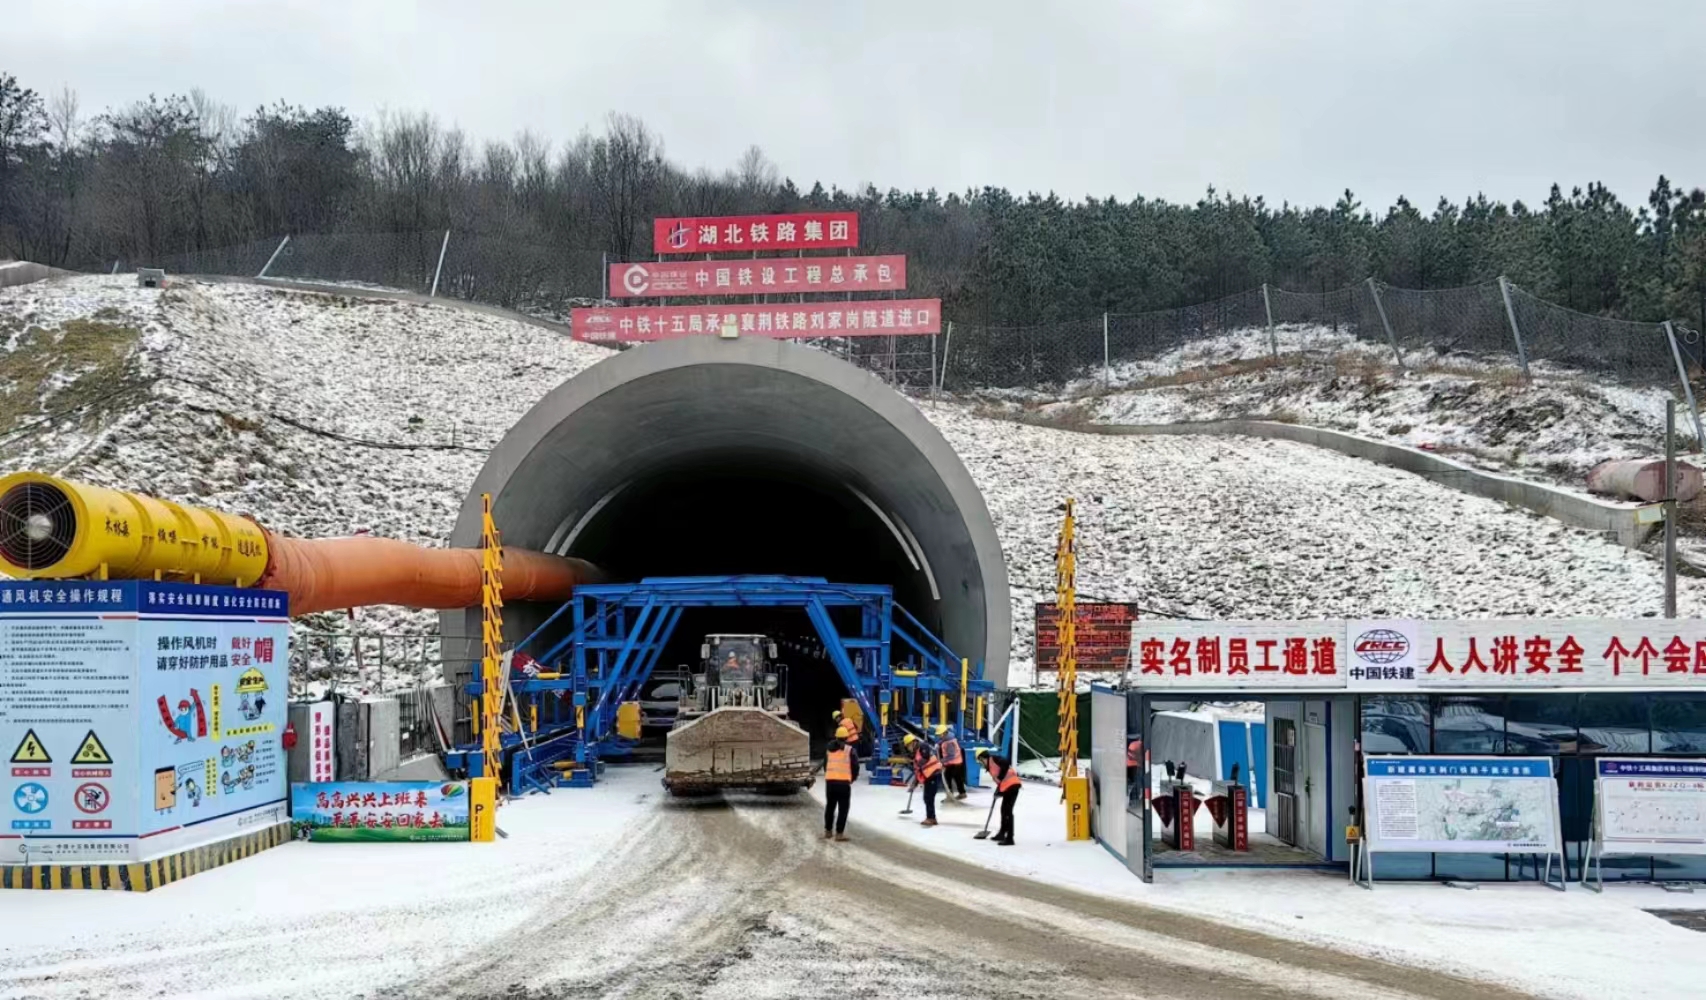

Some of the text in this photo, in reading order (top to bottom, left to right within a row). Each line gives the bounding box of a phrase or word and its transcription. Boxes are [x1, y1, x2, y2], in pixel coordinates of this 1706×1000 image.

[697, 219, 850, 245] 湖北铁路集团
[695, 264, 892, 288] 中国铁设工程总承包
[620, 308, 929, 335] 中铁十五局承襄荆铁路刘家岗隧道进口
[2, 588, 122, 603] 通风机安全操作规程
[157, 635, 274, 664] 操作风机时 戴好 帽
[1140, 636, 1337, 678] 实名制员工通道
[1426, 635, 1585, 675] 人人讲安全
[157, 653, 252, 671] 请穿好防护用品 安全
[1349, 666, 1416, 681] 中国铁建
[316, 791, 428, 809] 高高兴兴上班来
[333, 811, 444, 829] 平平安安回家去
